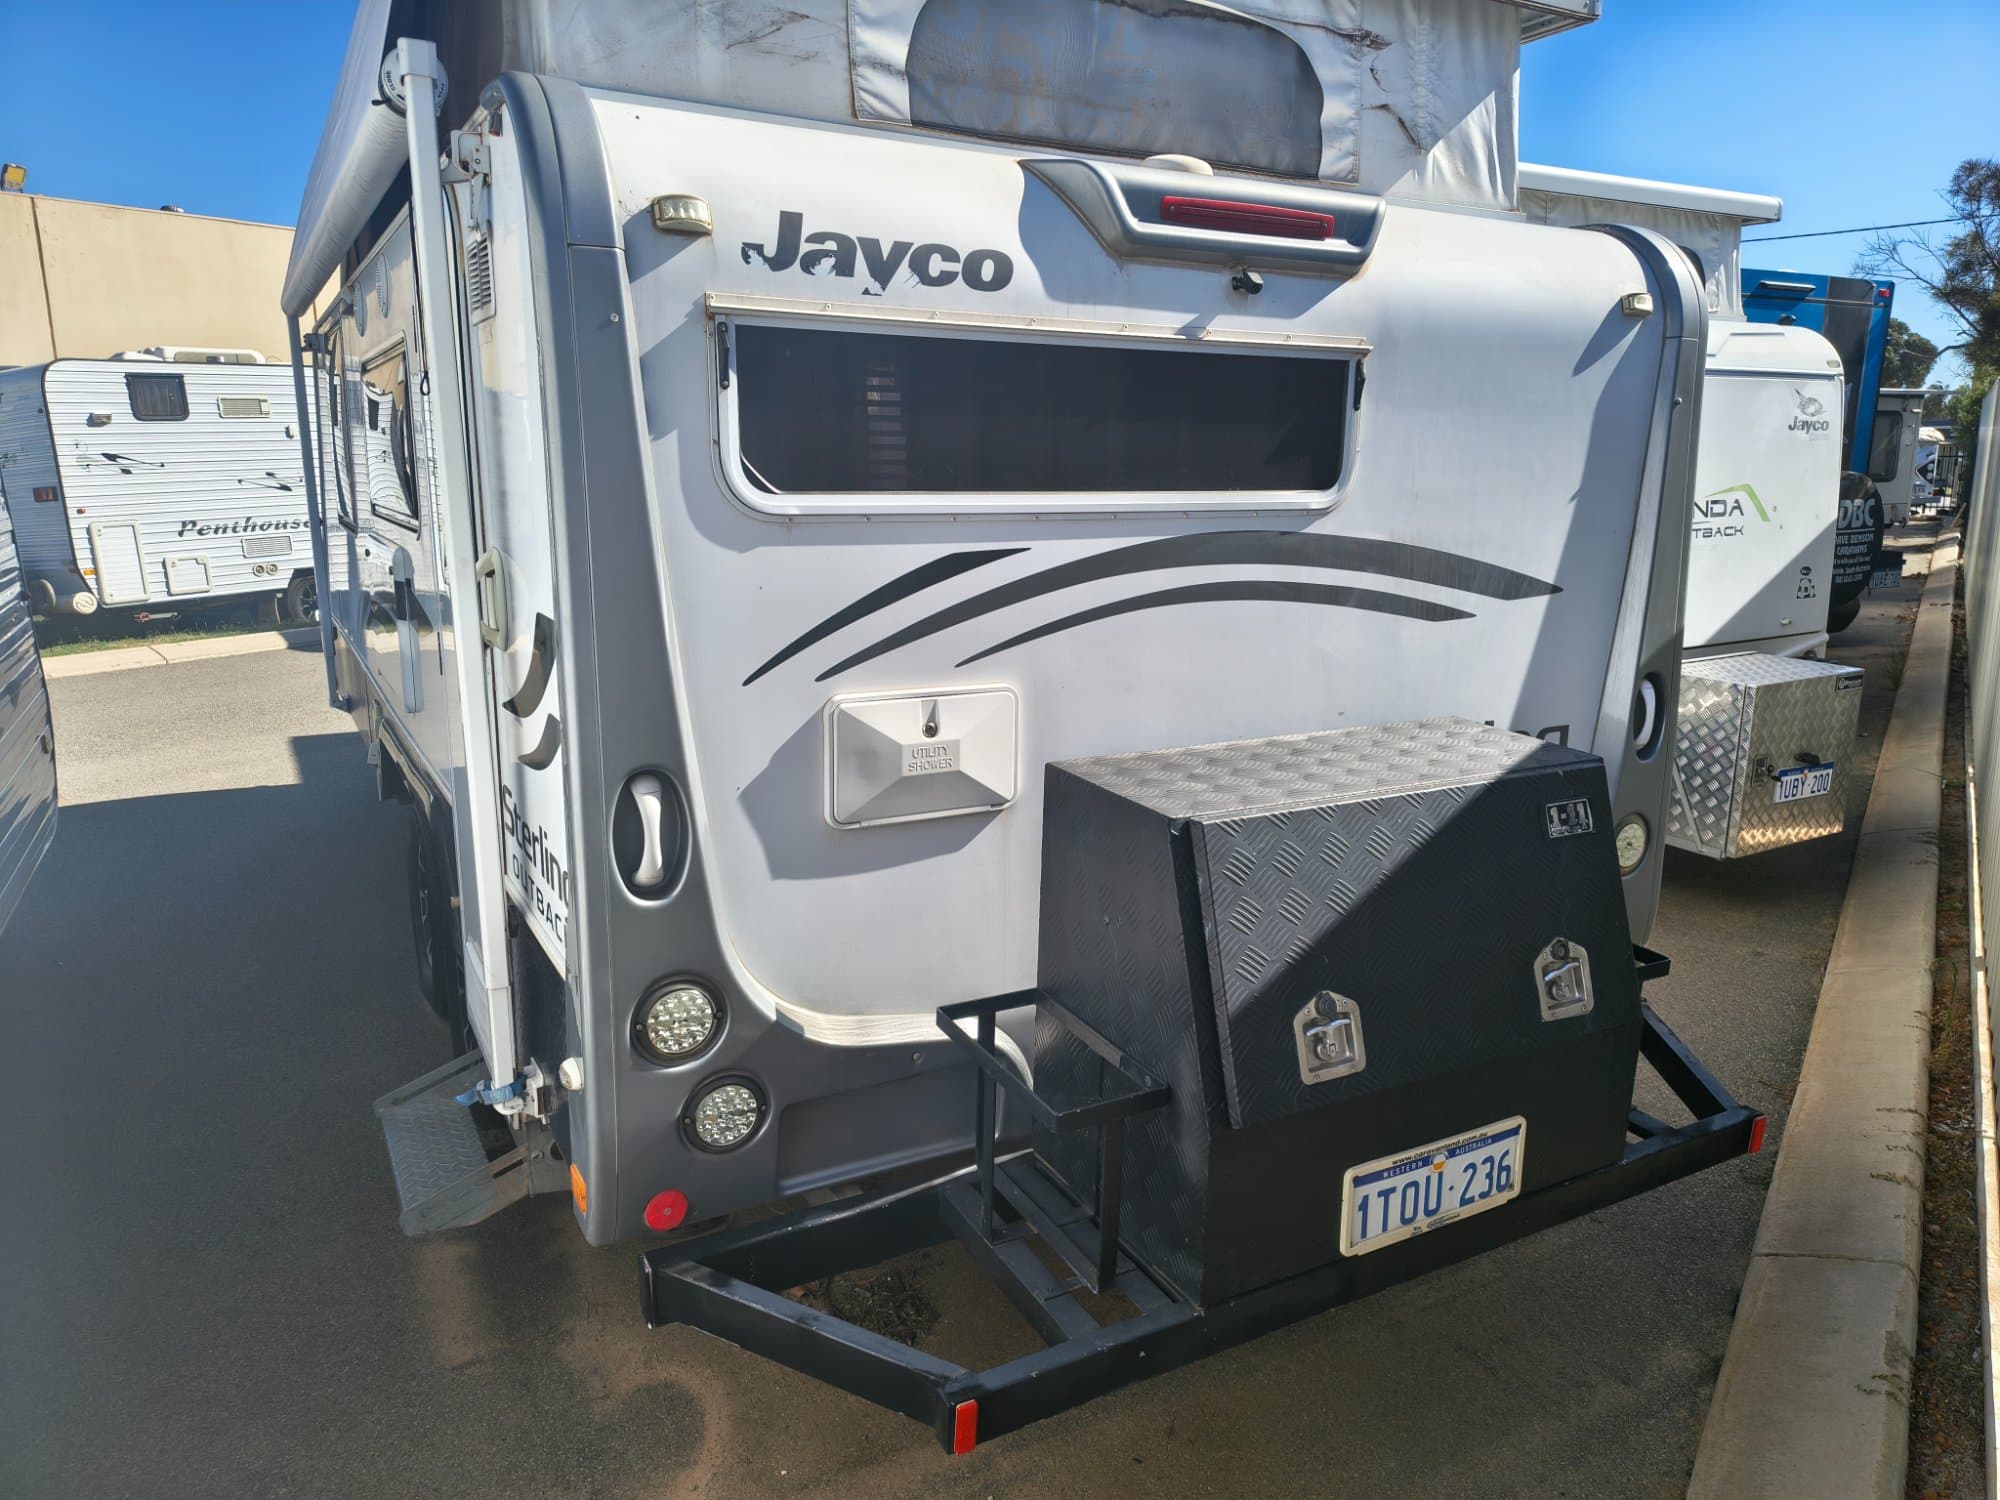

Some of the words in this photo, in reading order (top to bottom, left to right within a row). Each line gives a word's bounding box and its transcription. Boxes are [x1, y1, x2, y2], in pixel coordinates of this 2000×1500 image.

[741, 210, 1014, 296] Jayco
[1787, 415, 1830, 435] Jayco
[1692, 498, 1745, 519] NDA
[1837, 498, 1876, 529] DBC
[1691, 525, 1745, 539] TBACK
[911, 744, 951, 760] UTILITY
[907, 757, 953, 773] SHOWER
[513, 853, 568, 945] OUTBAC
[1383, 1161, 1423, 1179] WESTERN
[1455, 1137, 1493, 1156] AUSTRALIA
